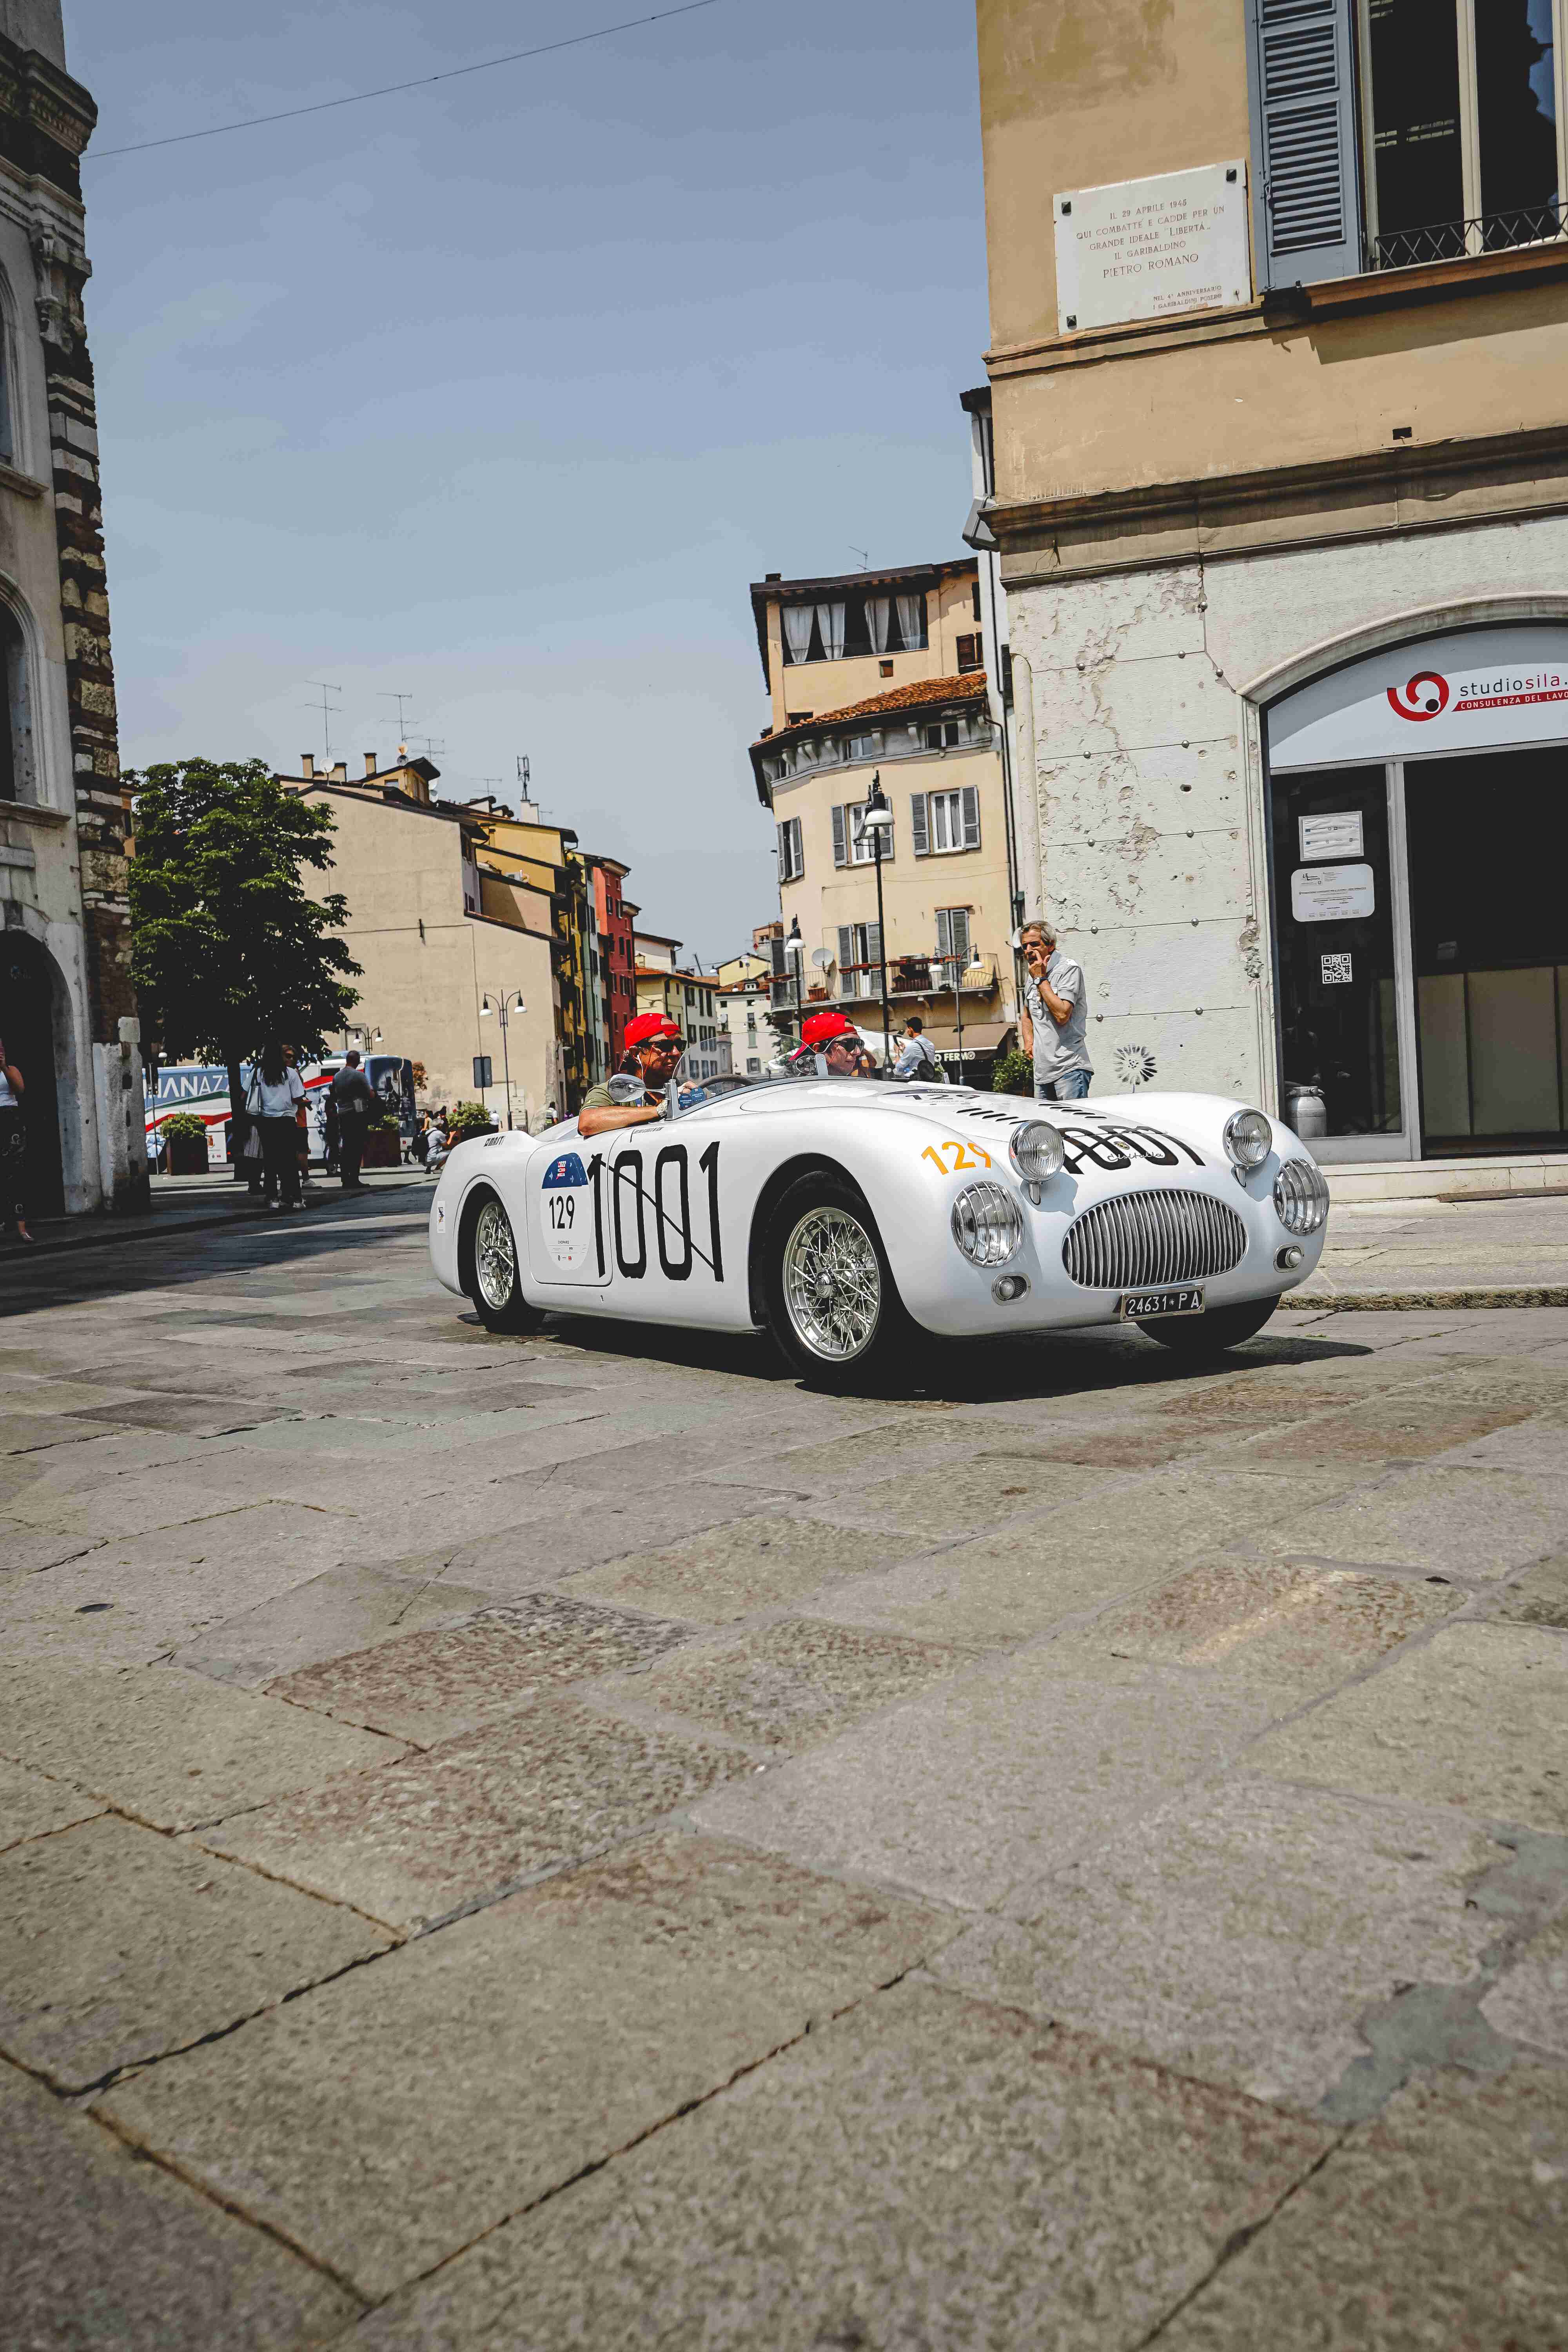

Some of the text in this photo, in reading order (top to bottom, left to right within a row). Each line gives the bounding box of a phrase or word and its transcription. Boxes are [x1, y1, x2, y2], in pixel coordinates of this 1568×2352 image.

[1136, 203, 1164, 215] APRILE
[1076, 230, 1091, 240] QUI
[1158, 213, 1188, 225] CADDE
[1192, 209, 1208, 218] PER
[1214, 205, 1225, 214] UN
[1089, 238, 1125, 250] GRANDE
[1129, 232, 1160, 244] IDEALE
[1114, 240, 1186, 260] IL GARIBALDINO
[1103, 254, 1198, 279] PIETRO ROMANO
[1176, 285, 1222, 298] ANNIVERSARIO
[1158, 297, 1197, 309] GARIBALDINI
[1461, 697, 1521, 709] CONSULENZA
[921, 1141, 991, 1175] 129
[549, 1195, 575, 1229] 129
[587, 1141, 724, 1283] 1001
[1128, 1295, 1167, 1314] 24631
